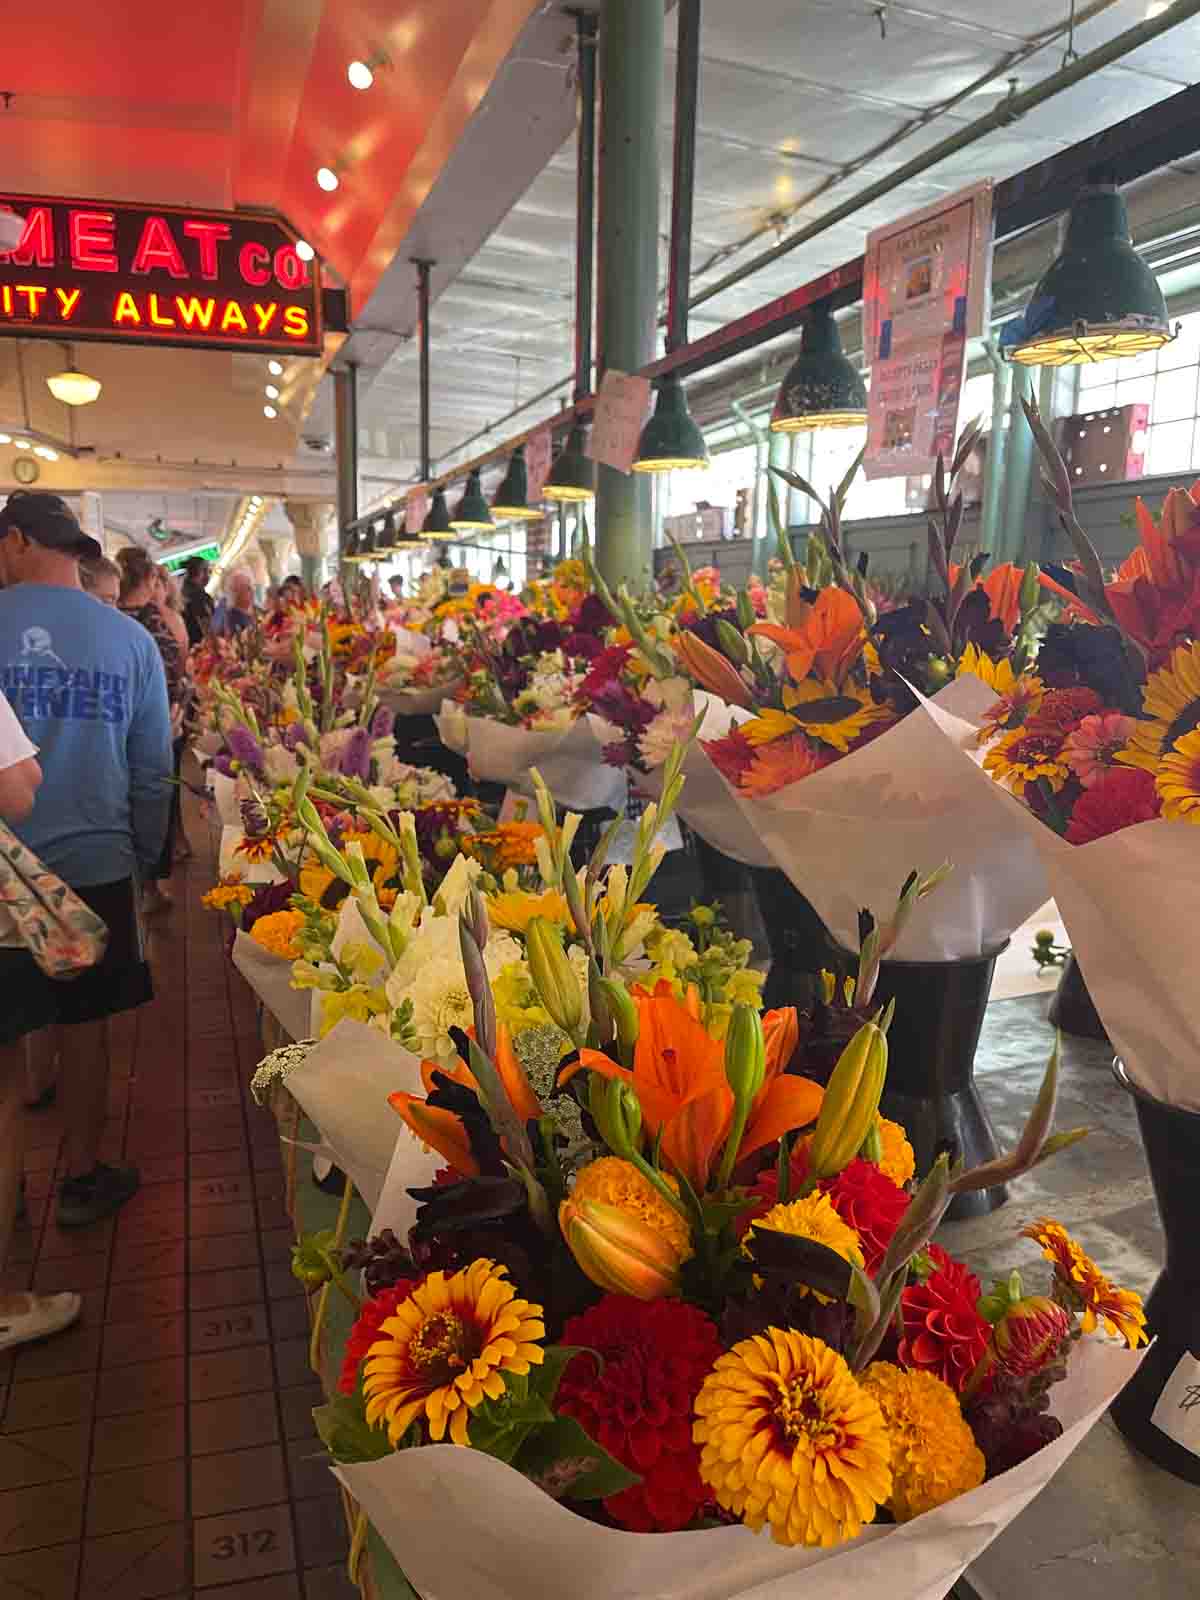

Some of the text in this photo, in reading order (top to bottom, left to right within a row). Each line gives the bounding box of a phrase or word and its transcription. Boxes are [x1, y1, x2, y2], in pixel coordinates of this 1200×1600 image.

[0, 205, 231, 279] MEAT
[113, 290, 309, 336] ALWAYS
[211, 1529, 279, 1560] 312
